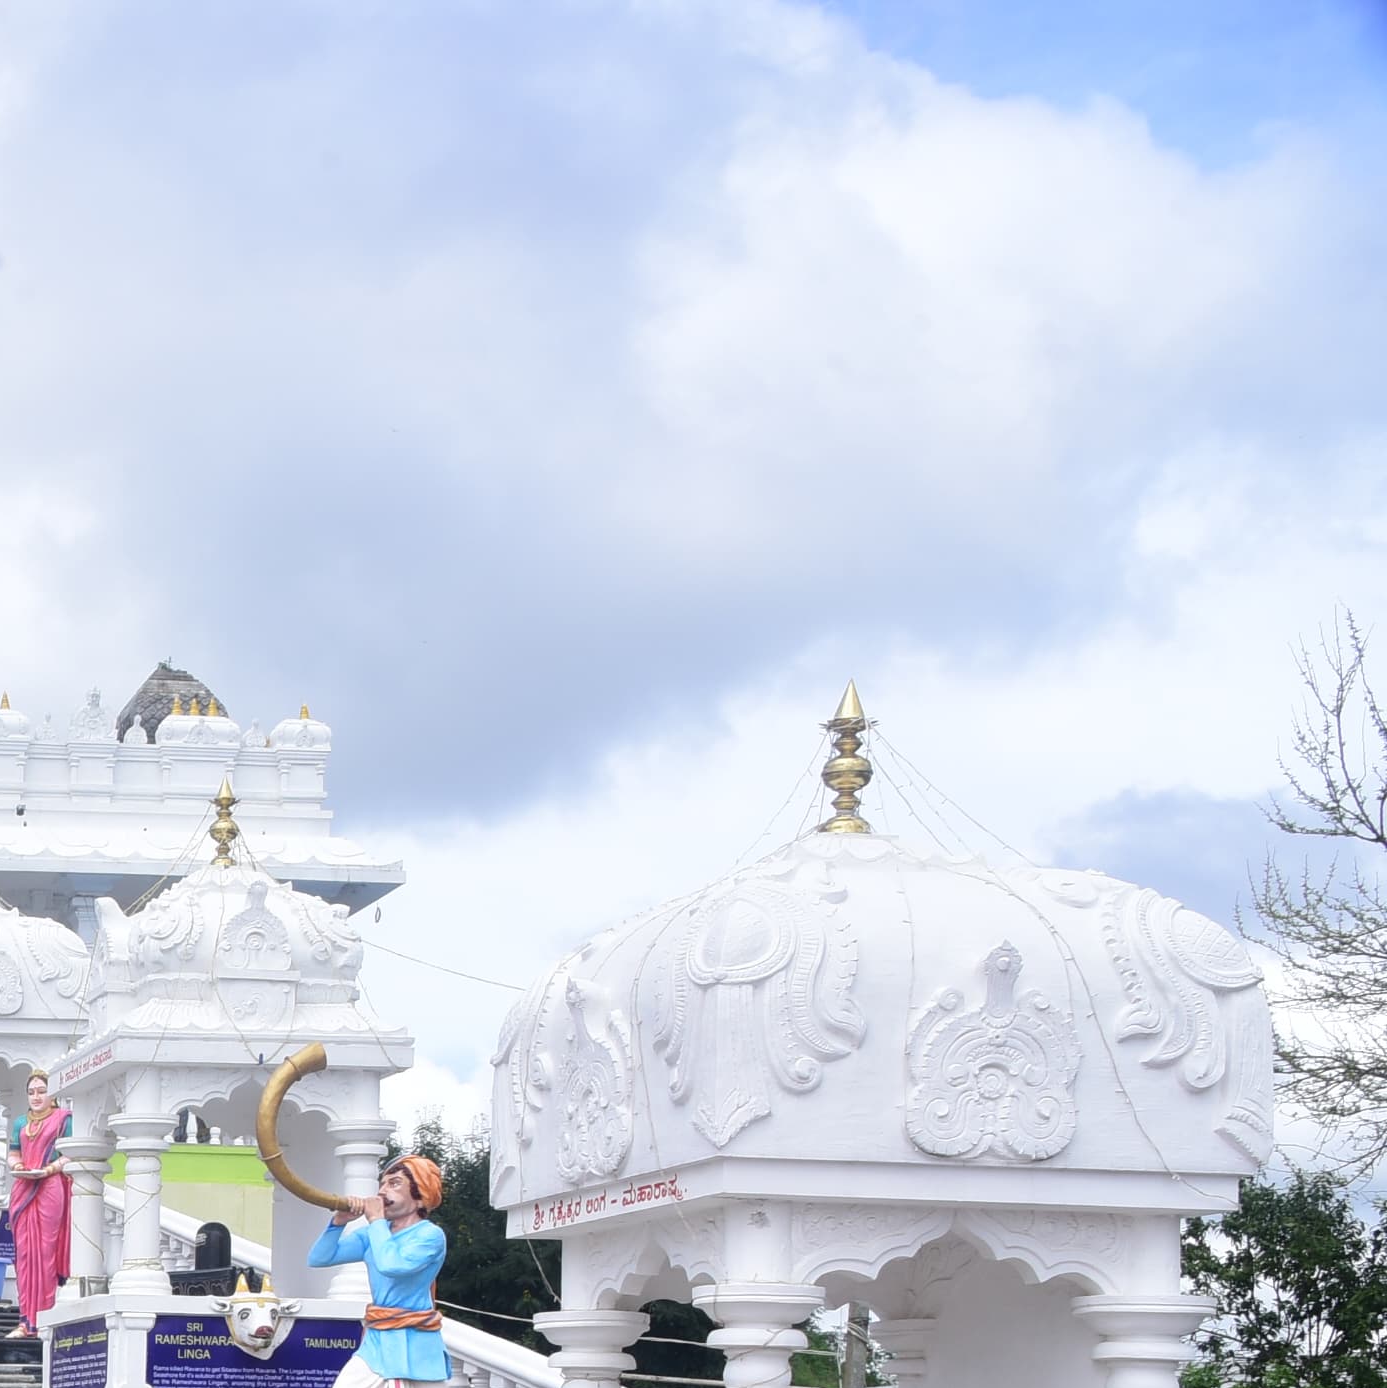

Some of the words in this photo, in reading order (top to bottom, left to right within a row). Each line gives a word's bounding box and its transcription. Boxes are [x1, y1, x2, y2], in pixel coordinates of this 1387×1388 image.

[187, 1323, 203, 1332] SRI
[155, 1334, 234, 1346] RAMESHWARA
[304, 1338, 356, 1349] TAMILNADU
[178, 1349, 211, 1360] LINGA
